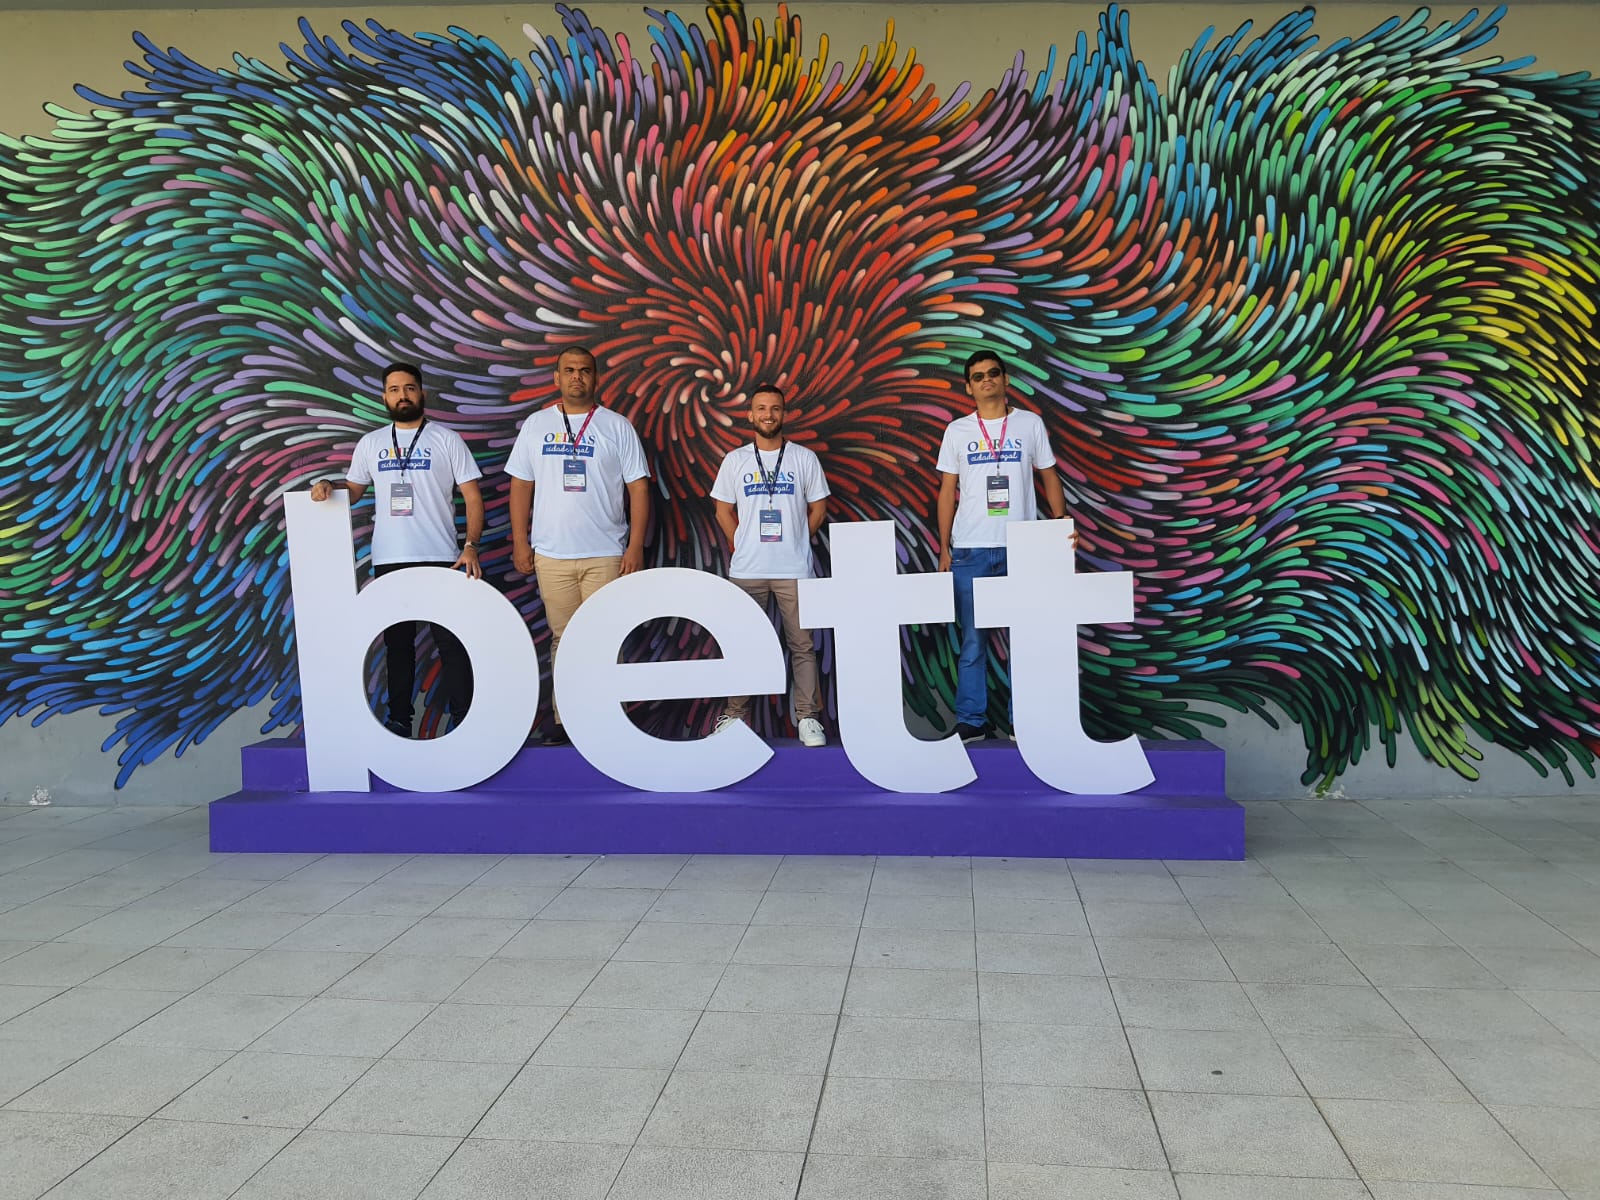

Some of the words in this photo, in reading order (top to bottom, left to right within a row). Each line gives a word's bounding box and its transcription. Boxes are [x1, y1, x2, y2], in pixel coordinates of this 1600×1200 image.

[967, 438, 1022, 452] OERAS
[381, 460, 402, 469] cidad
[743, 471, 795, 484] OERAS
[284, 490, 1156, 794] bett
